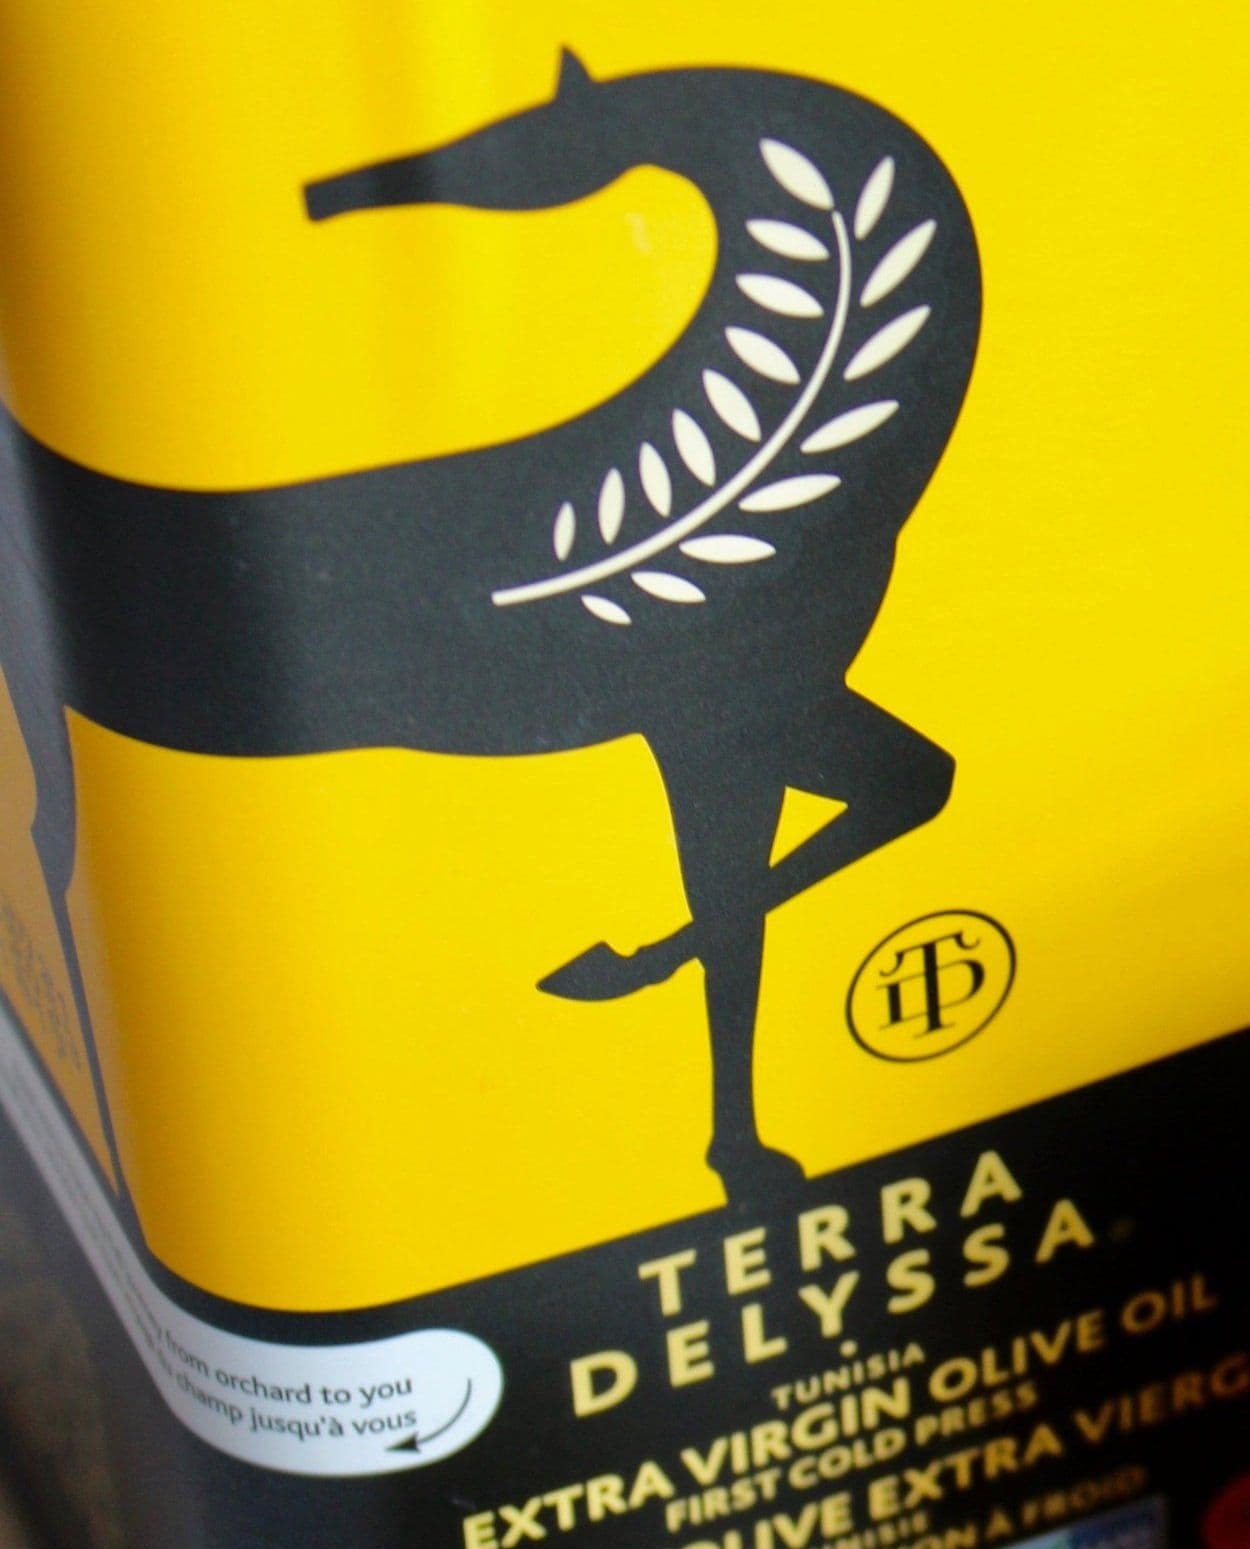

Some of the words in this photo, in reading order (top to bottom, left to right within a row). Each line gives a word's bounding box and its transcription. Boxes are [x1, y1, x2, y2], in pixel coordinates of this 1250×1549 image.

[638, 1150, 1022, 1317] TERRA
[166, 1331, 210, 1377] from
[215, 1367, 311, 1405] orchard
[321, 1384, 351, 1405] to
[358, 1377, 413, 1409] you
[570, 1199, 1095, 1418] DELYSSA
[175, 1371, 243, 1425] champ
[250, 1407, 344, 1442] jusqu'à
[351, 1410, 418, 1436] vous
[680, 1376, 911, 1487] VIRGIN
[928, 1309, 1105, 1402] OLIVE
[1121, 1273, 1220, 1335] OIL
[771, 1341, 925, 1411] TUNISIA
[665, 1467, 783, 1534] FIRST
[788, 1427, 907, 1491] COLD
[913, 1379, 1040, 1447] PRESS
[867, 1423, 1064, 1522] EXTRA
